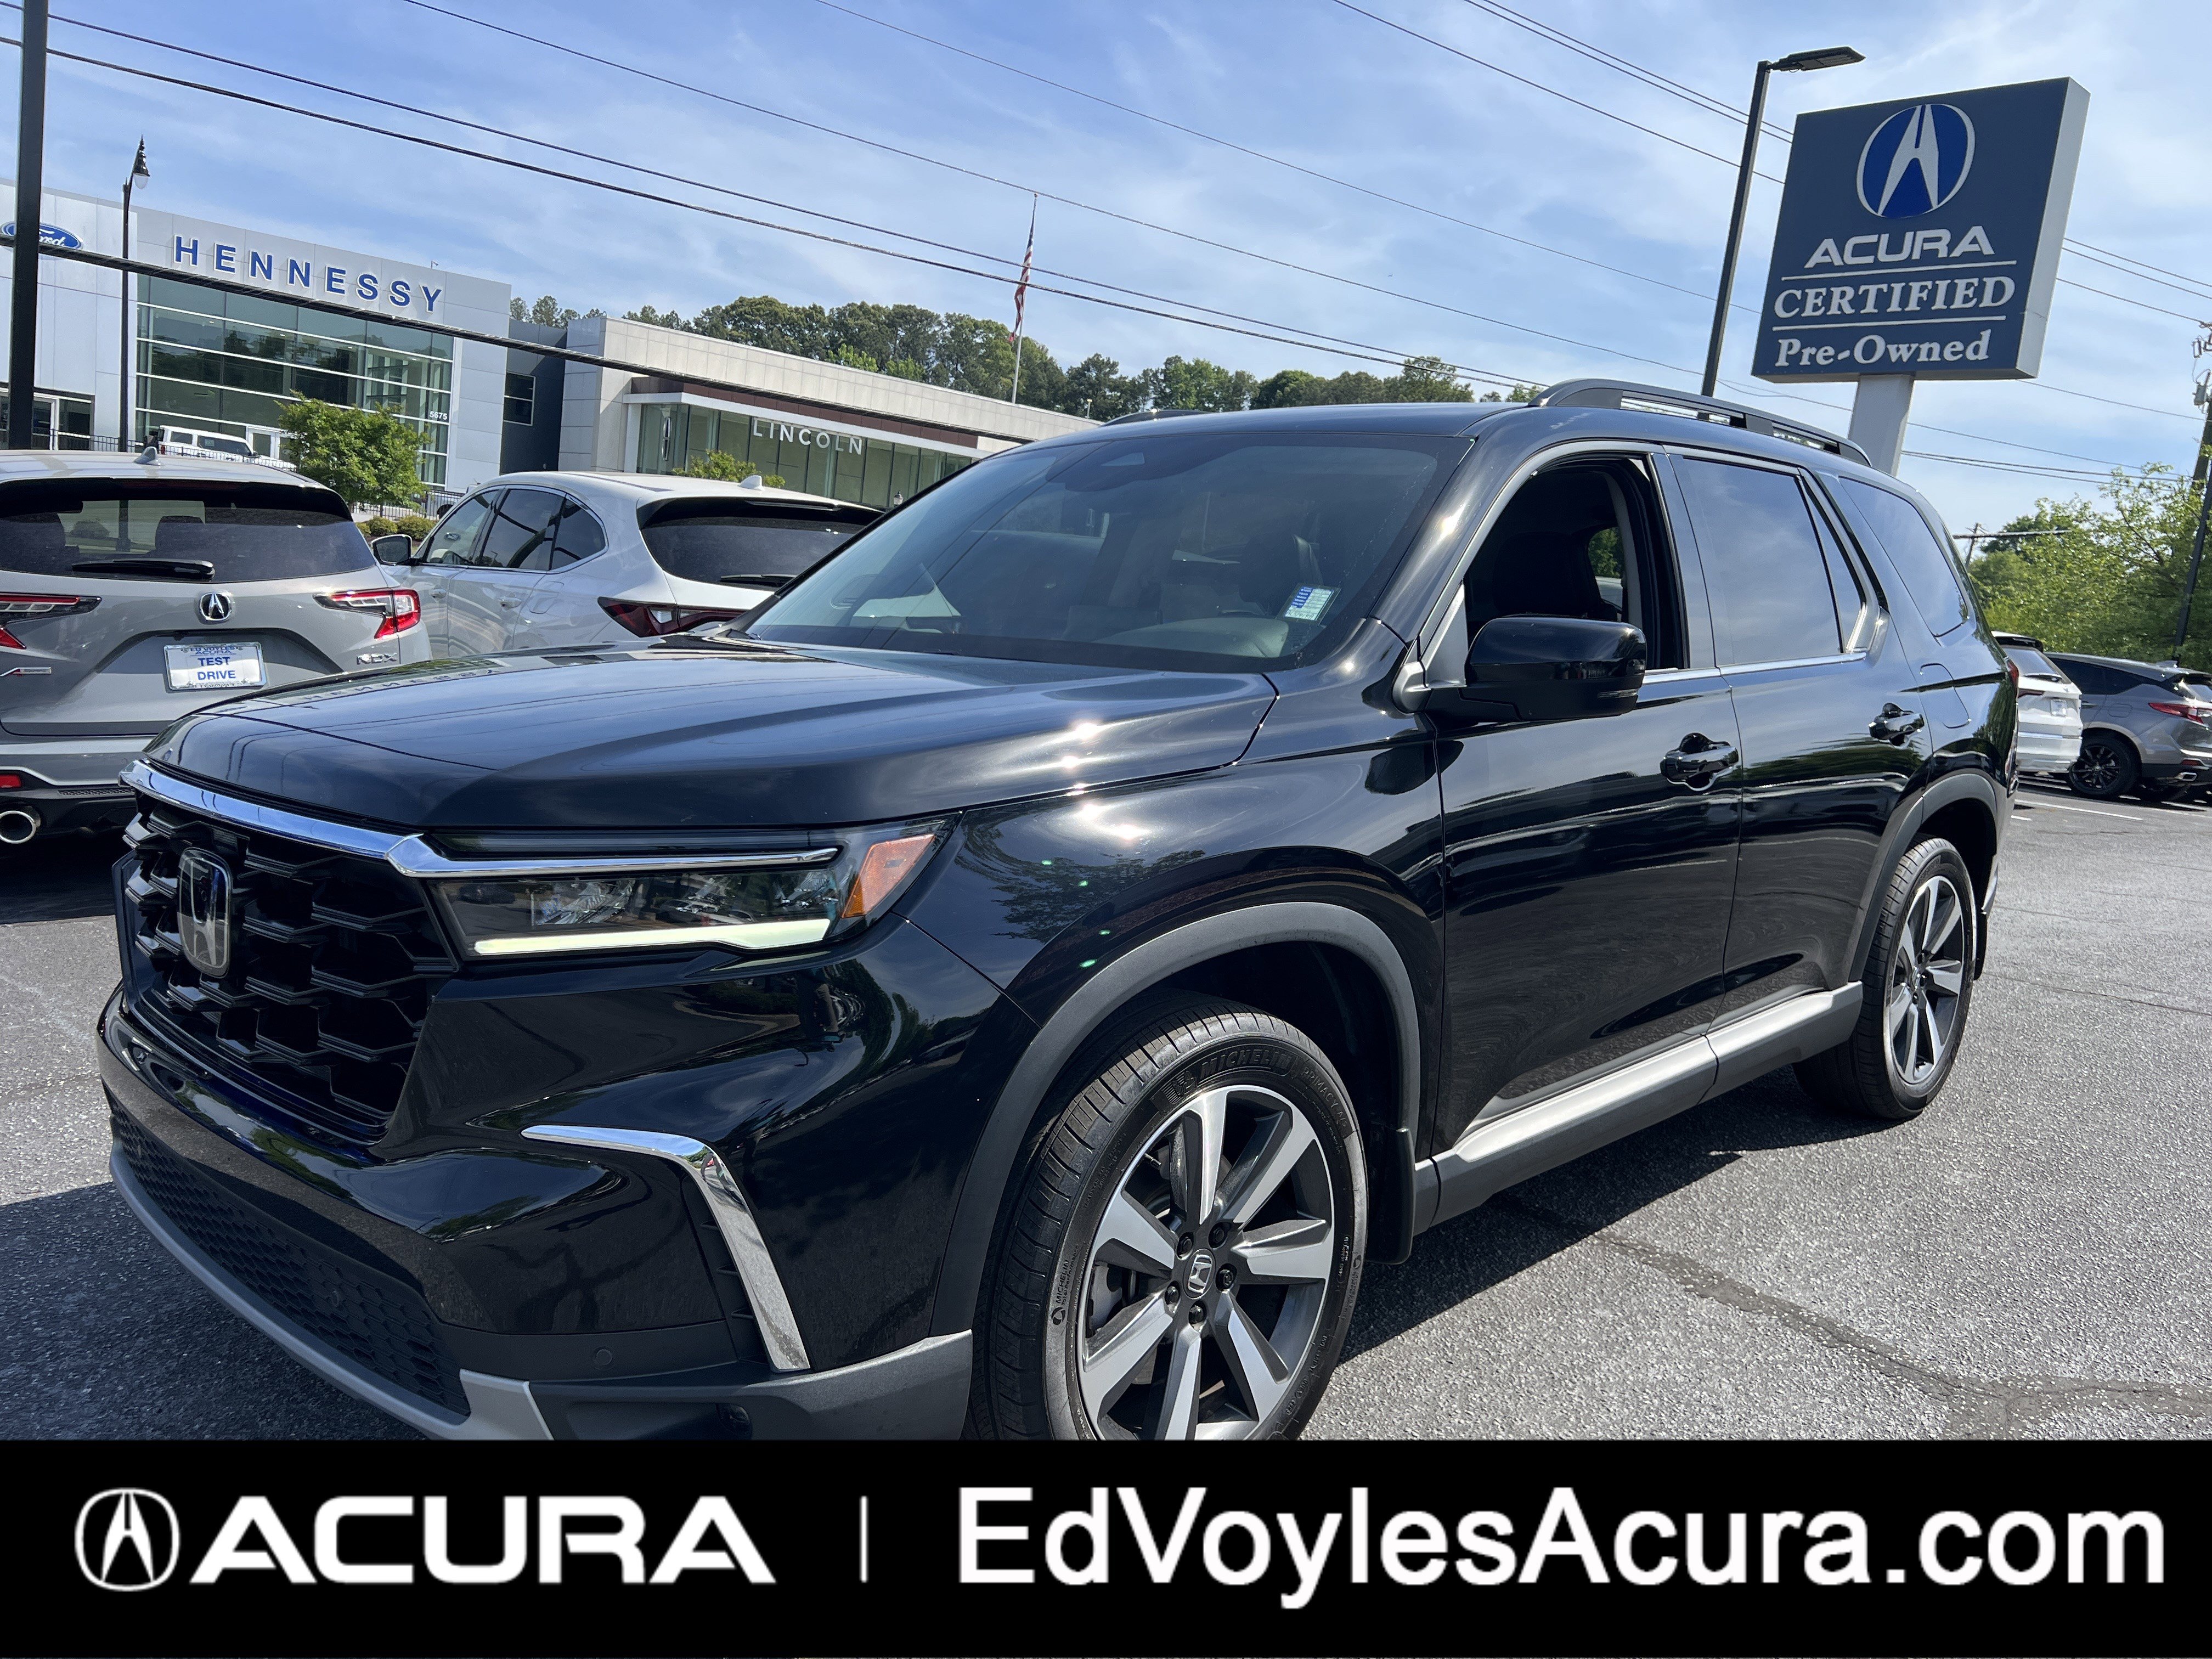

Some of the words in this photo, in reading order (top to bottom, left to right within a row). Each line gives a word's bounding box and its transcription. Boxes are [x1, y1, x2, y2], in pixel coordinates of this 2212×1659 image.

[1804, 225, 1995, 268] ACURA
[173, 235, 442, 313] HENNESSY
[1774, 275, 2016, 318] CERTIFIED
[1775, 329, 1992, 367] Pre-Owned
[429, 411, 448, 420] 5675
[753, 419, 862, 455] LINCOLN
[197, 670, 236, 680] DRIVE
[198, 657, 230, 667] TEST
[1200, 1048, 1293, 1078] MICHELIN
[1302, 1066, 1339, 1107] PRIMACY
[1336, 1110, 1348, 1128] A/S
[1056, 1259, 1070, 1304] MICHELIN
